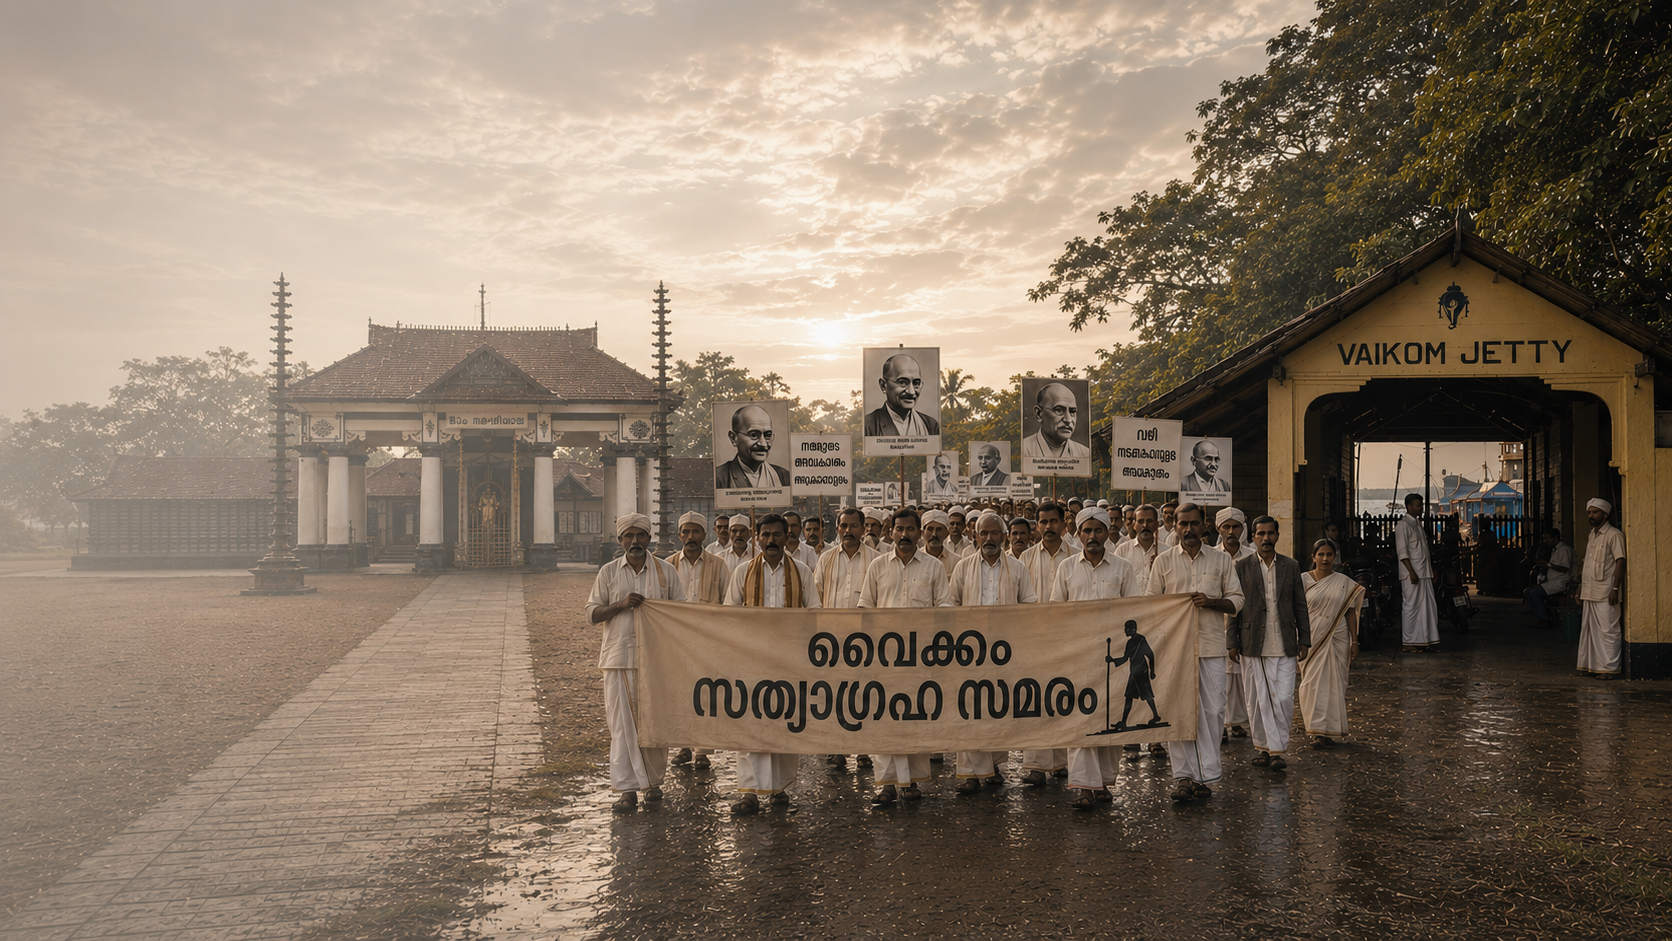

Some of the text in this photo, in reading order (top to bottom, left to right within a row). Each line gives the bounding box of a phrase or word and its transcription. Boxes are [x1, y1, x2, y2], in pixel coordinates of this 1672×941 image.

[1337, 339, 1573, 366] VAIKOM JETTY
[807, 629, 1013, 668] വൈക്കം
[692, 676, 1098, 734] സത്യാഗ്രഹ സമരം
